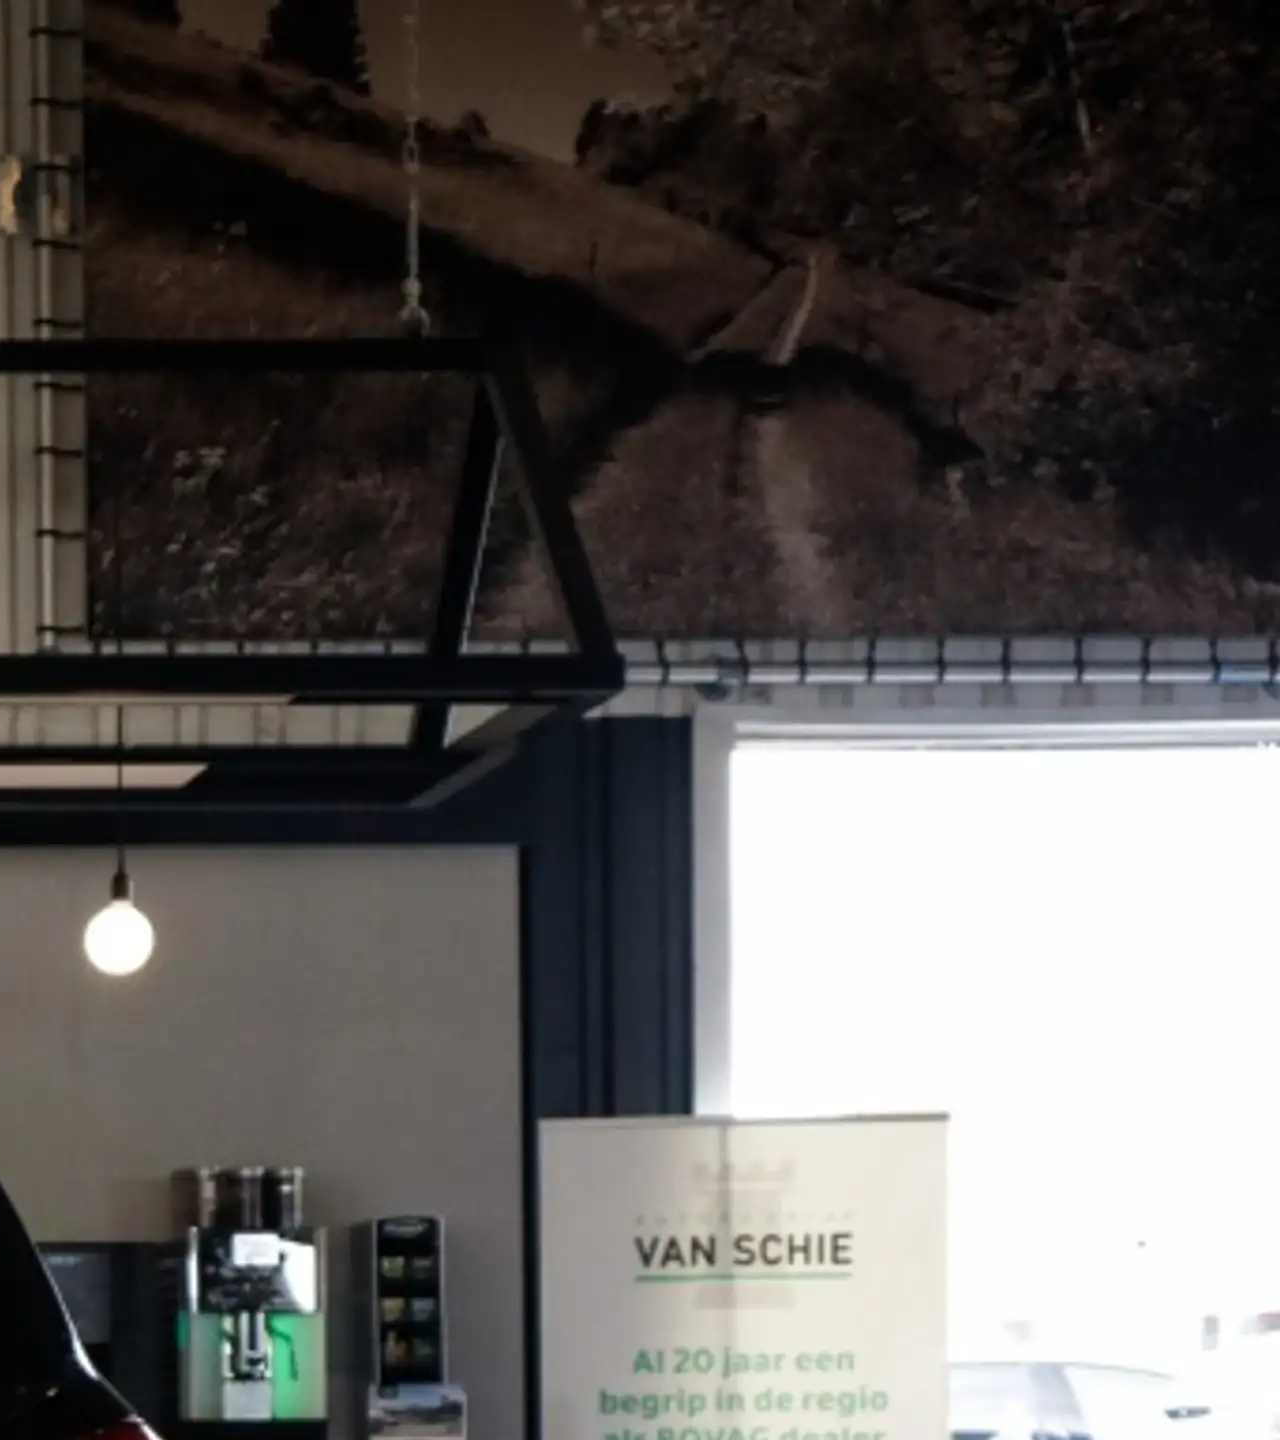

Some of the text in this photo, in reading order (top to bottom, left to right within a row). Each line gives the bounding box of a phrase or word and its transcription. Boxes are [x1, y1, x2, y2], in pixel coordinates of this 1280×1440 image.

[634, 1231, 854, 1268] VAN SCHIE
[632, 1346, 856, 1377] Al 20 jaar een
[598, 1385, 889, 1419] begrip in de regio
